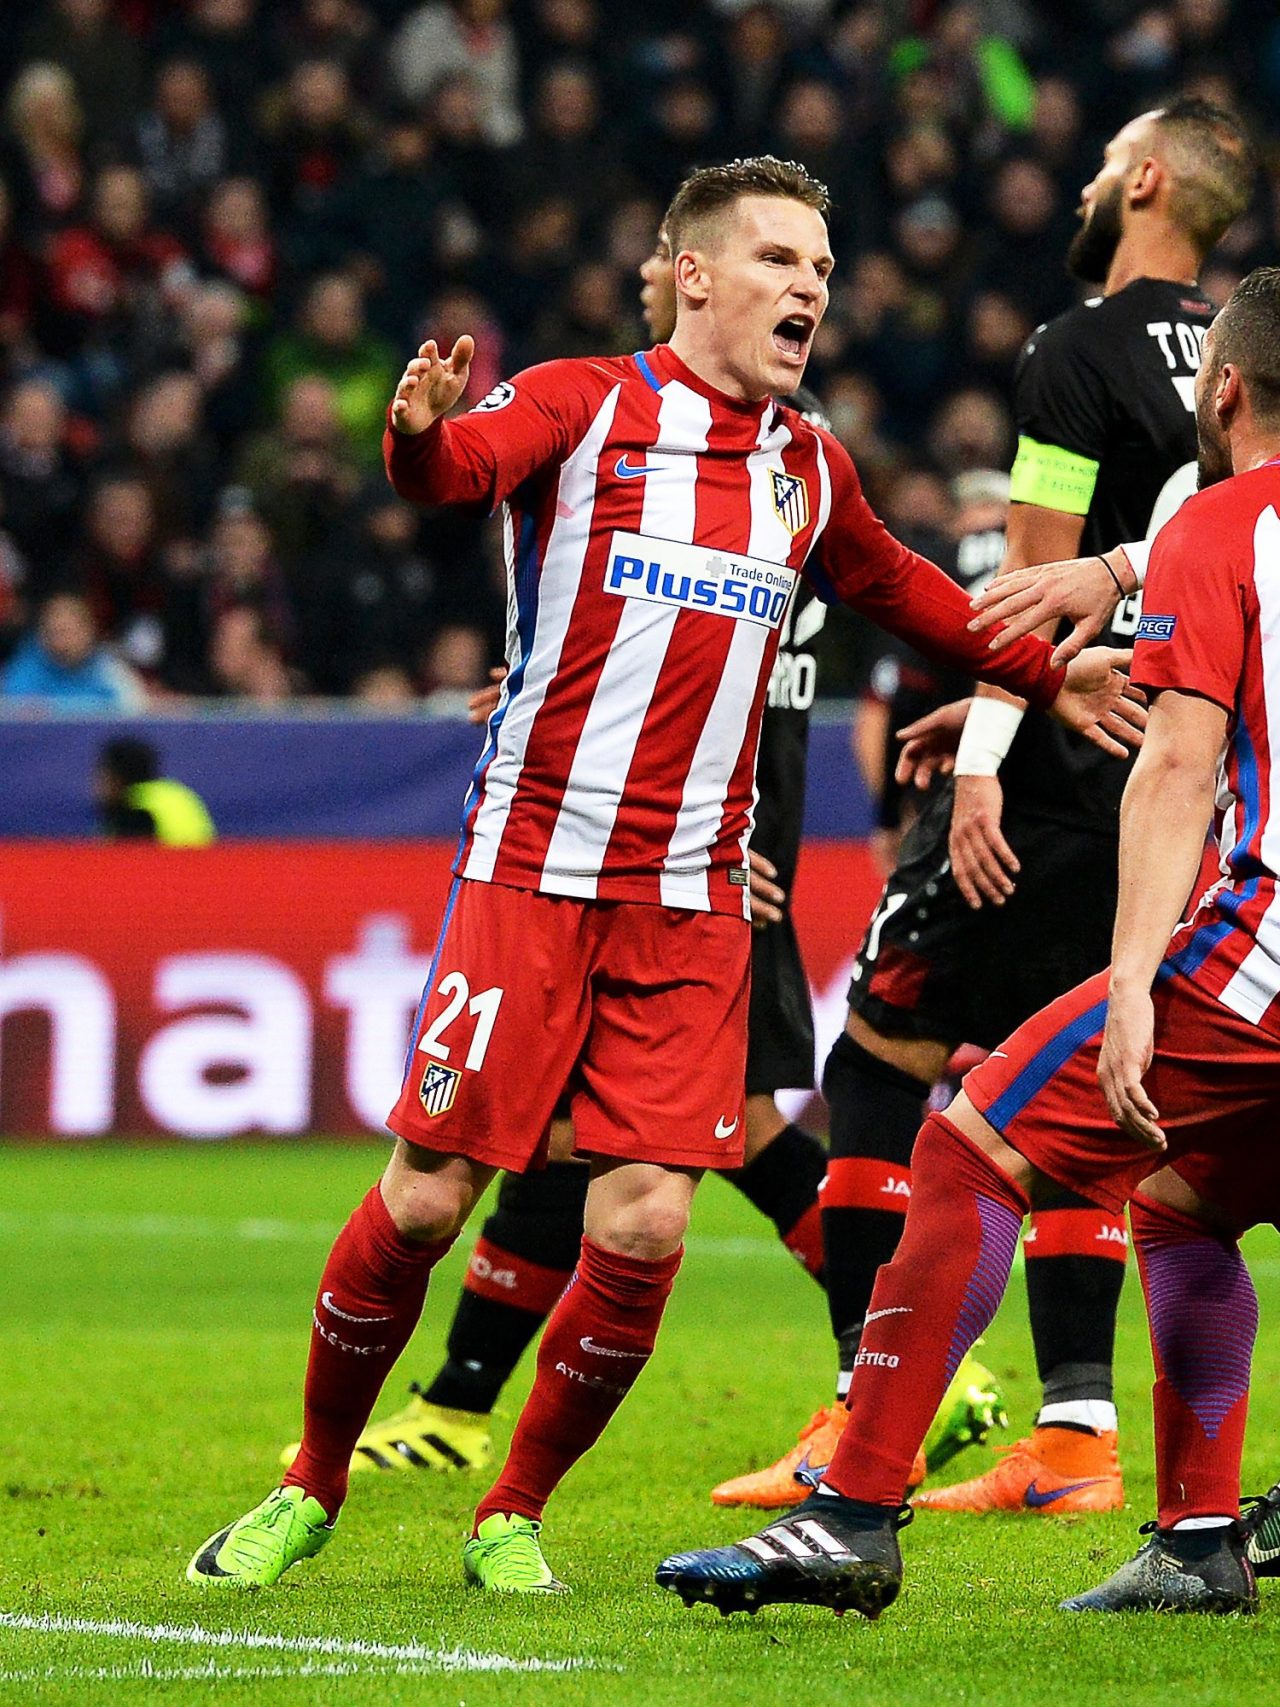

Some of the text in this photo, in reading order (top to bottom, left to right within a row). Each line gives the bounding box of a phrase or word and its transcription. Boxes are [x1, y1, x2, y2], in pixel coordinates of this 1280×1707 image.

[609, 555, 787, 623] Plus500
[730, 563, 792, 591] Trade Online
[418, 971, 504, 1073] 21
